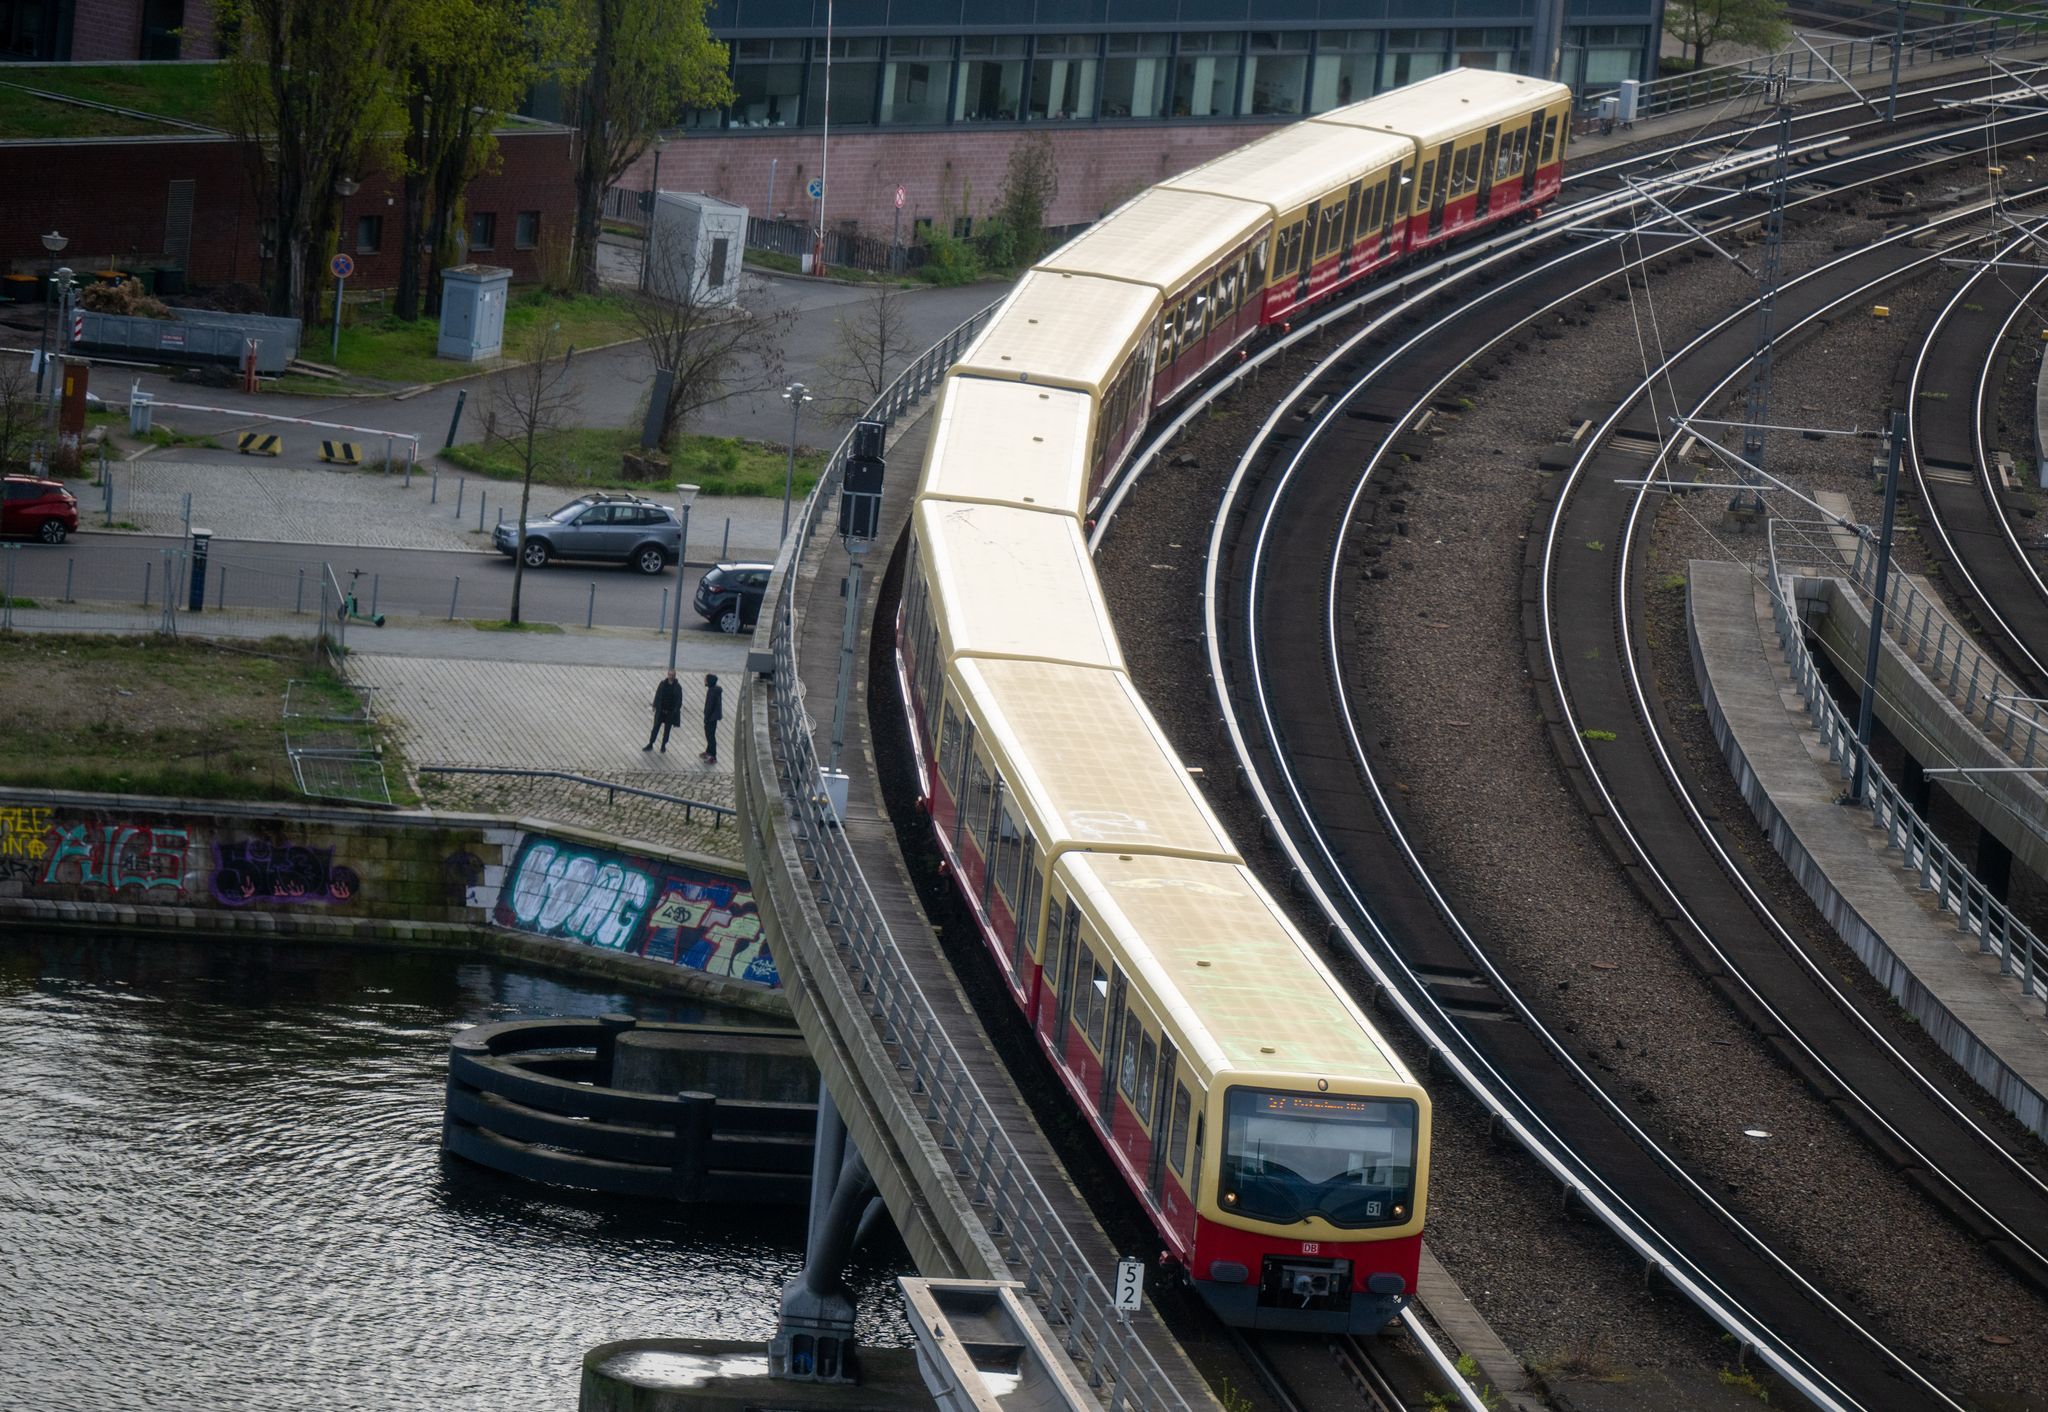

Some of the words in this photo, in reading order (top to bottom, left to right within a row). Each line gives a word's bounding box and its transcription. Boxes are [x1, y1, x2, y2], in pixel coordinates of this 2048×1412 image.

[1368, 1203, 1380, 1215] 51
[1303, 1243, 1318, 1253] DB
[1124, 1266, 1137, 1283] 5
[1123, 1286, 1135, 1304] 2
